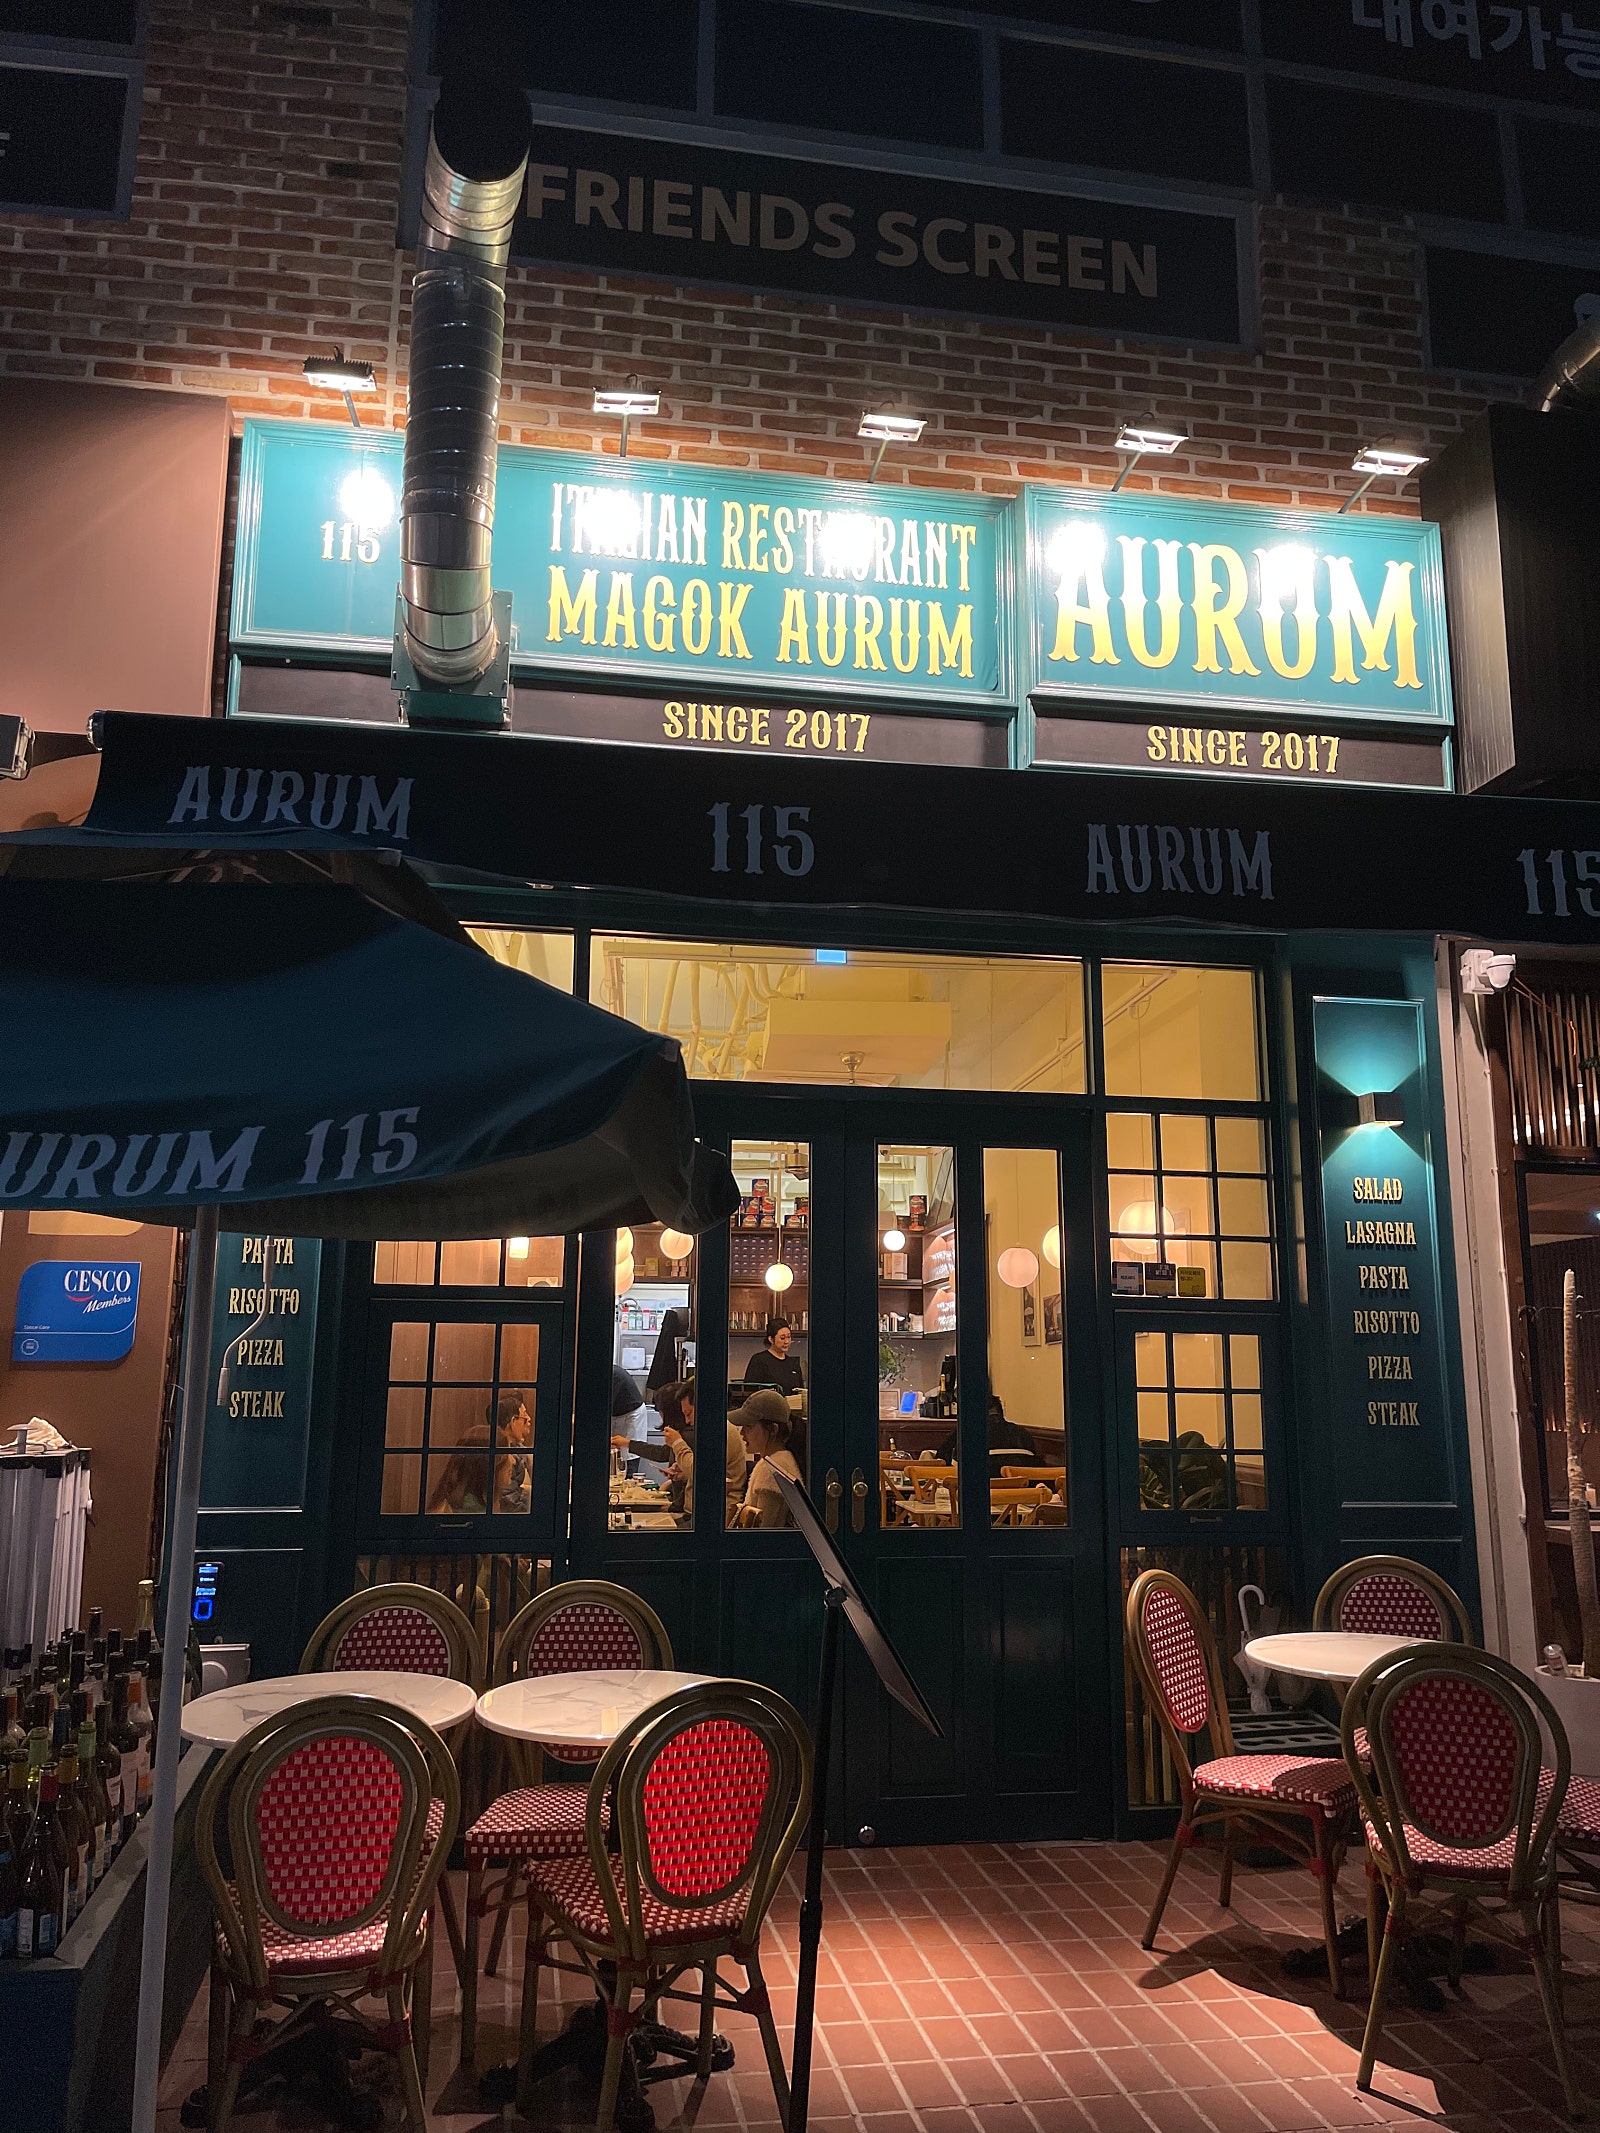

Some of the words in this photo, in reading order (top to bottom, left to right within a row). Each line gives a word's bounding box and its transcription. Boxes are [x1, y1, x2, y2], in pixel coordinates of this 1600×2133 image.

[526, 162, 857, 259] FRIENDS
[875, 210, 1158, 298] SCREEN
[320, 520, 380, 563] 115
[721, 500, 977, 592] RESTRANT
[545, 564, 755, 660] MAGOK
[776, 587, 976, 679] AURUM
[1047, 522, 1424, 689] AURUM
[662, 701, 771, 746] SINCE
[785, 708, 871, 752] 2017
[1147, 725, 1249, 767] SINCE
[1260, 731, 1341, 773] 2017
[167, 765, 415, 839] AURUM
[706, 801, 815, 877] 115
[1085, 822, 1275, 900] AURUM
[1516, 848, 1600, 918] 115
[297, 1106, 421, 1184] 115
[1353, 1176, 1403, 1201] SALAD
[241, 1237, 294, 1265] PATA
[1345, 1220, 1417, 1245] LASAGNA
[64, 1269, 131, 1293] CESCO
[1358, 1265, 1410, 1290] PASTA
[82, 1294, 132, 1314] Members
[1353, 1310, 1420, 1335] RISOTTO
[236, 1339, 284, 1366] PIZZA
[1367, 1355, 1413, 1380] PIZZA
[228, 1390, 286, 1418] STEAK
[1367, 1401, 1420, 1426] STEAK
